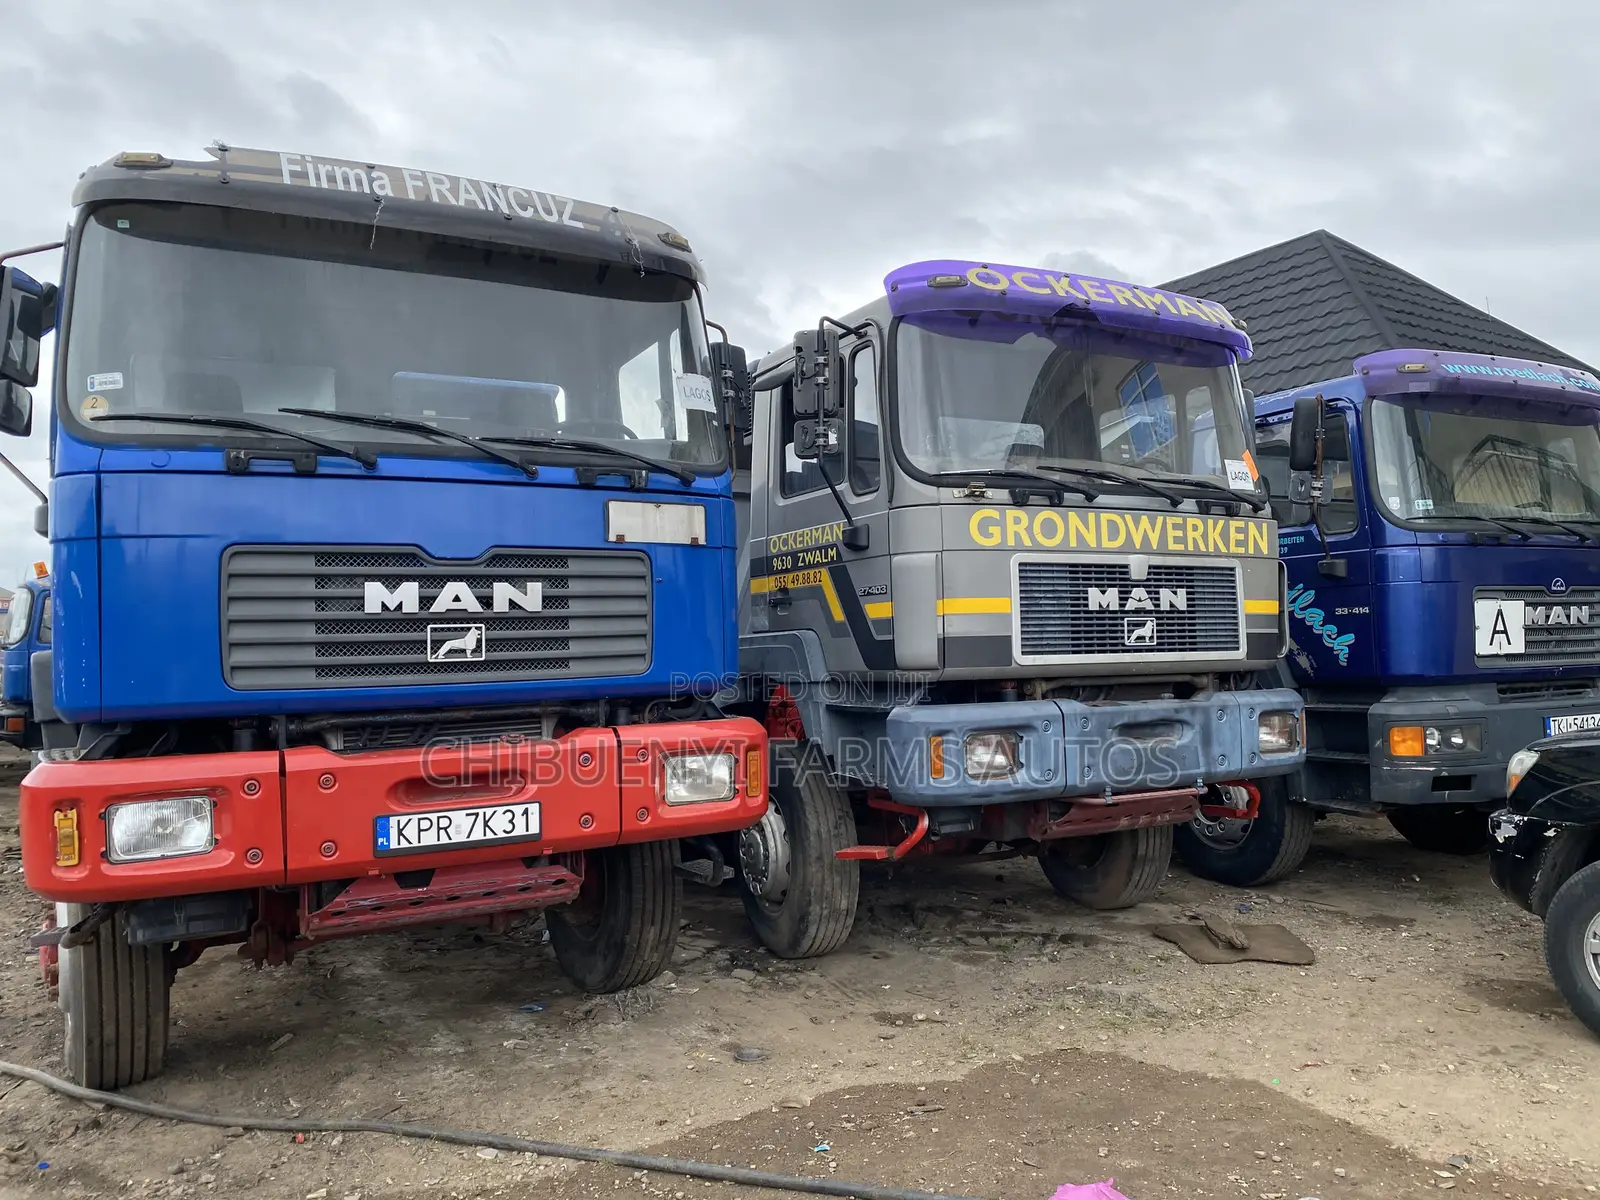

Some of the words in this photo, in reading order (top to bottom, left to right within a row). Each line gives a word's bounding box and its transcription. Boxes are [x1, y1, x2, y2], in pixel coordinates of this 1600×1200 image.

[279, 152, 394, 198] Firma
[401, 167, 585, 229] FRANCUZ
[966, 266, 1235, 329] OCKERMAN
[90, 397, 99, 409] 2
[683, 386, 712, 402] LAGOS
[770, 522, 845, 554] OCKERMAN
[968, 508, 1269, 555] GRONDWERKEN
[1279, 535, 1305, 545] RBEITEN
[772, 556, 792, 571] 9630
[797, 547, 837, 567] ZWALM
[790, 570, 823, 586] 49.88.82
[364, 581, 543, 614] MAN
[1088, 587, 1188, 611] MAN
[1489, 608, 1512, 646] A
[1525, 605, 1590, 626] MAN
[397, 815, 452, 846] KPR
[465, 806, 530, 839] 7K31
[378, 837, 389, 846] PL
